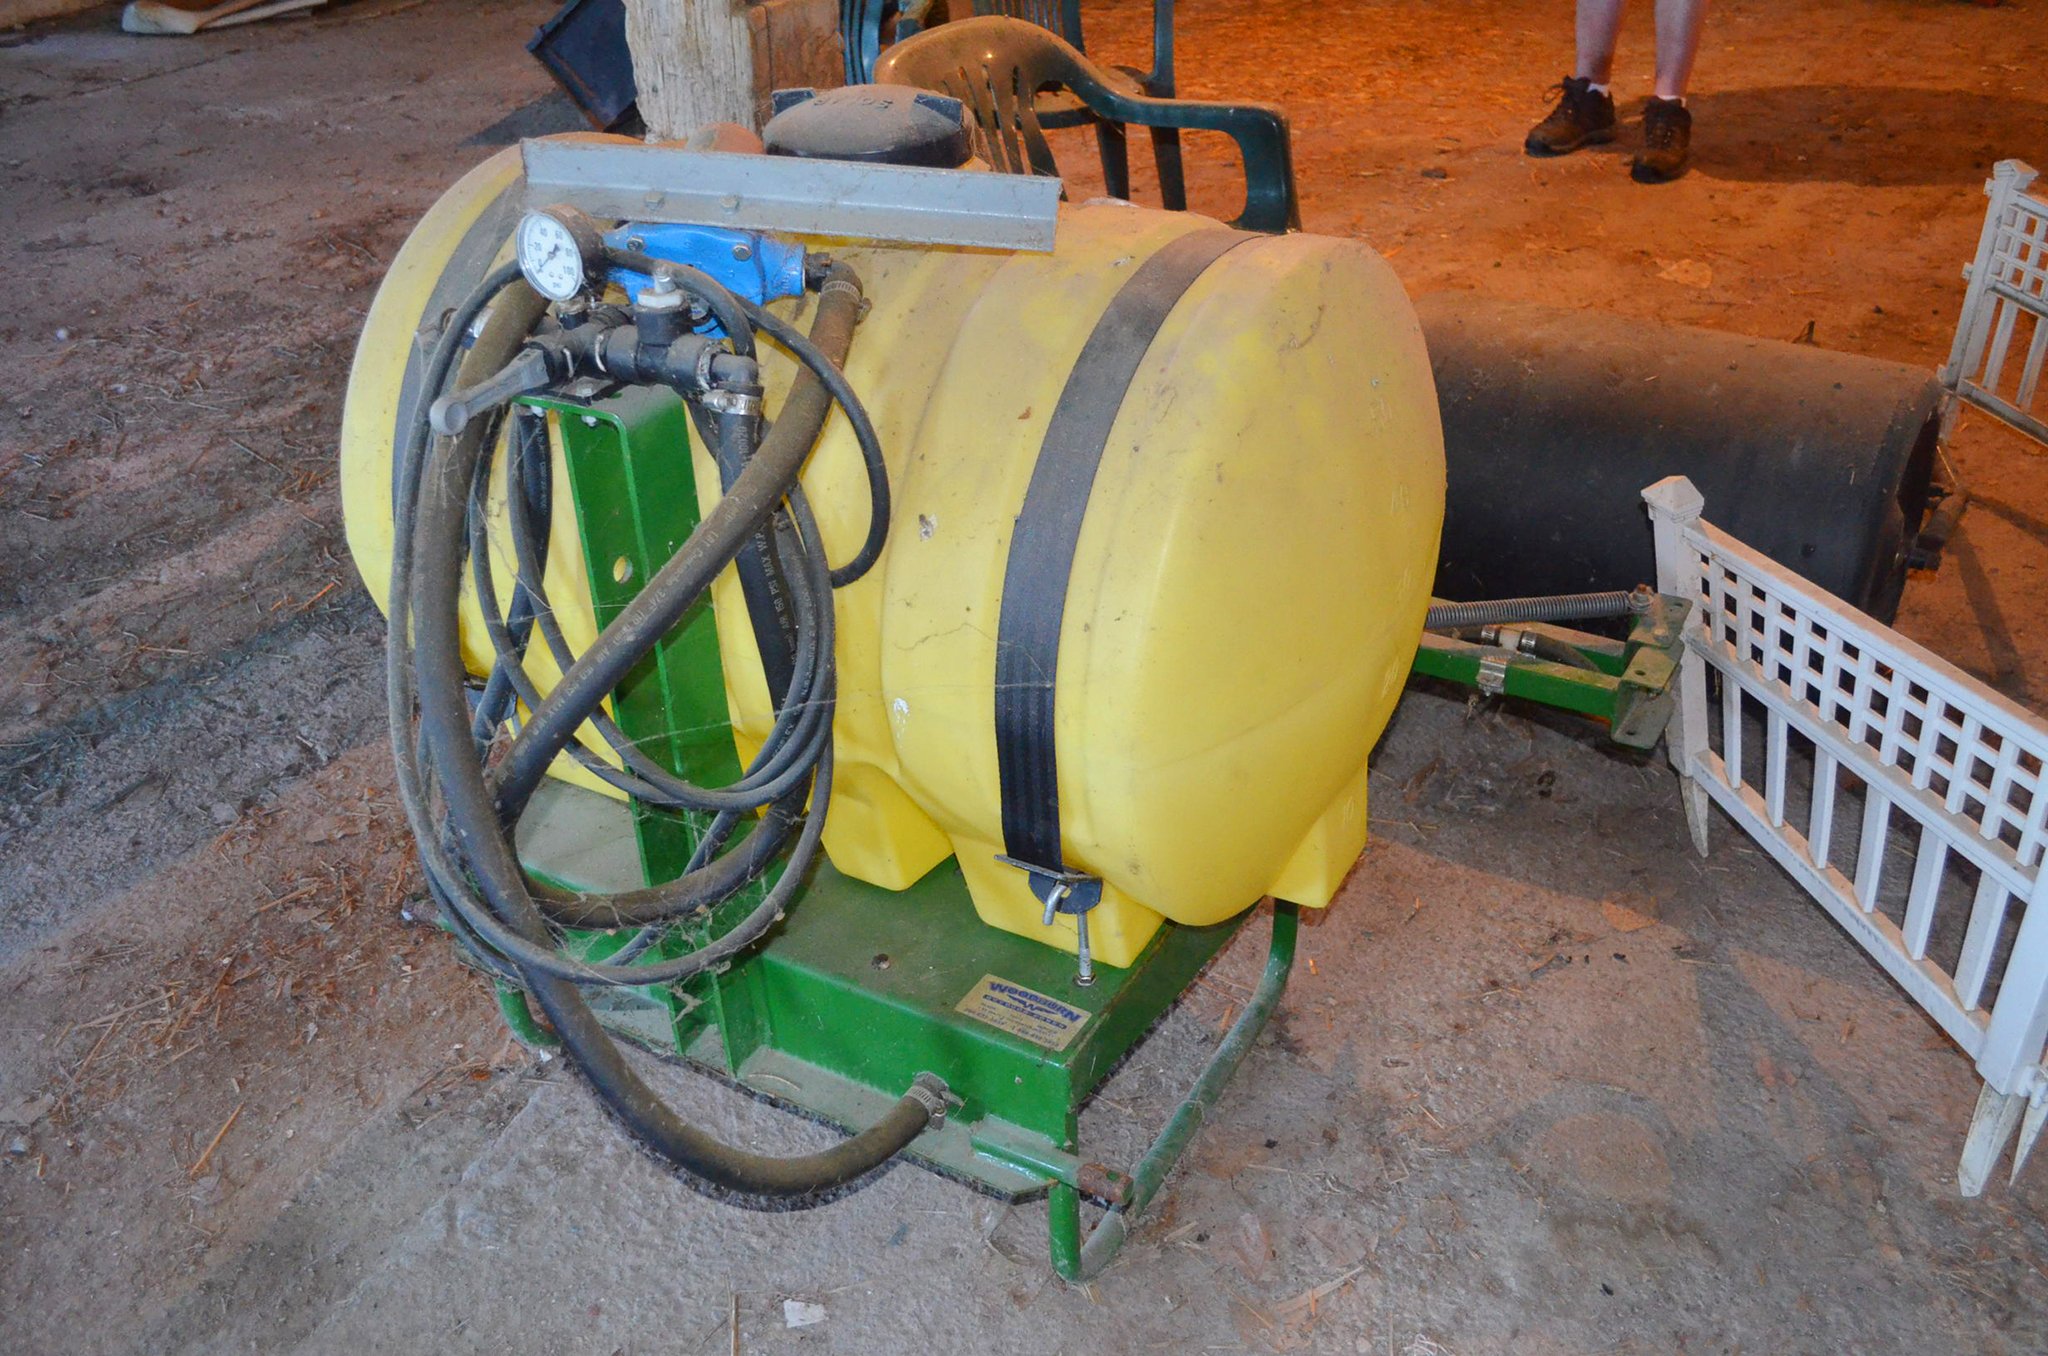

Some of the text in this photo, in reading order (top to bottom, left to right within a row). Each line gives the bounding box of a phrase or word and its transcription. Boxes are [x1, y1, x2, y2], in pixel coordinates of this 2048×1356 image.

[758, 552, 776, 577] MAX
[766, 578, 781, 595] PSI
[772, 595, 786, 613] 150
[990, 982, 1083, 1023] WOODBURN
